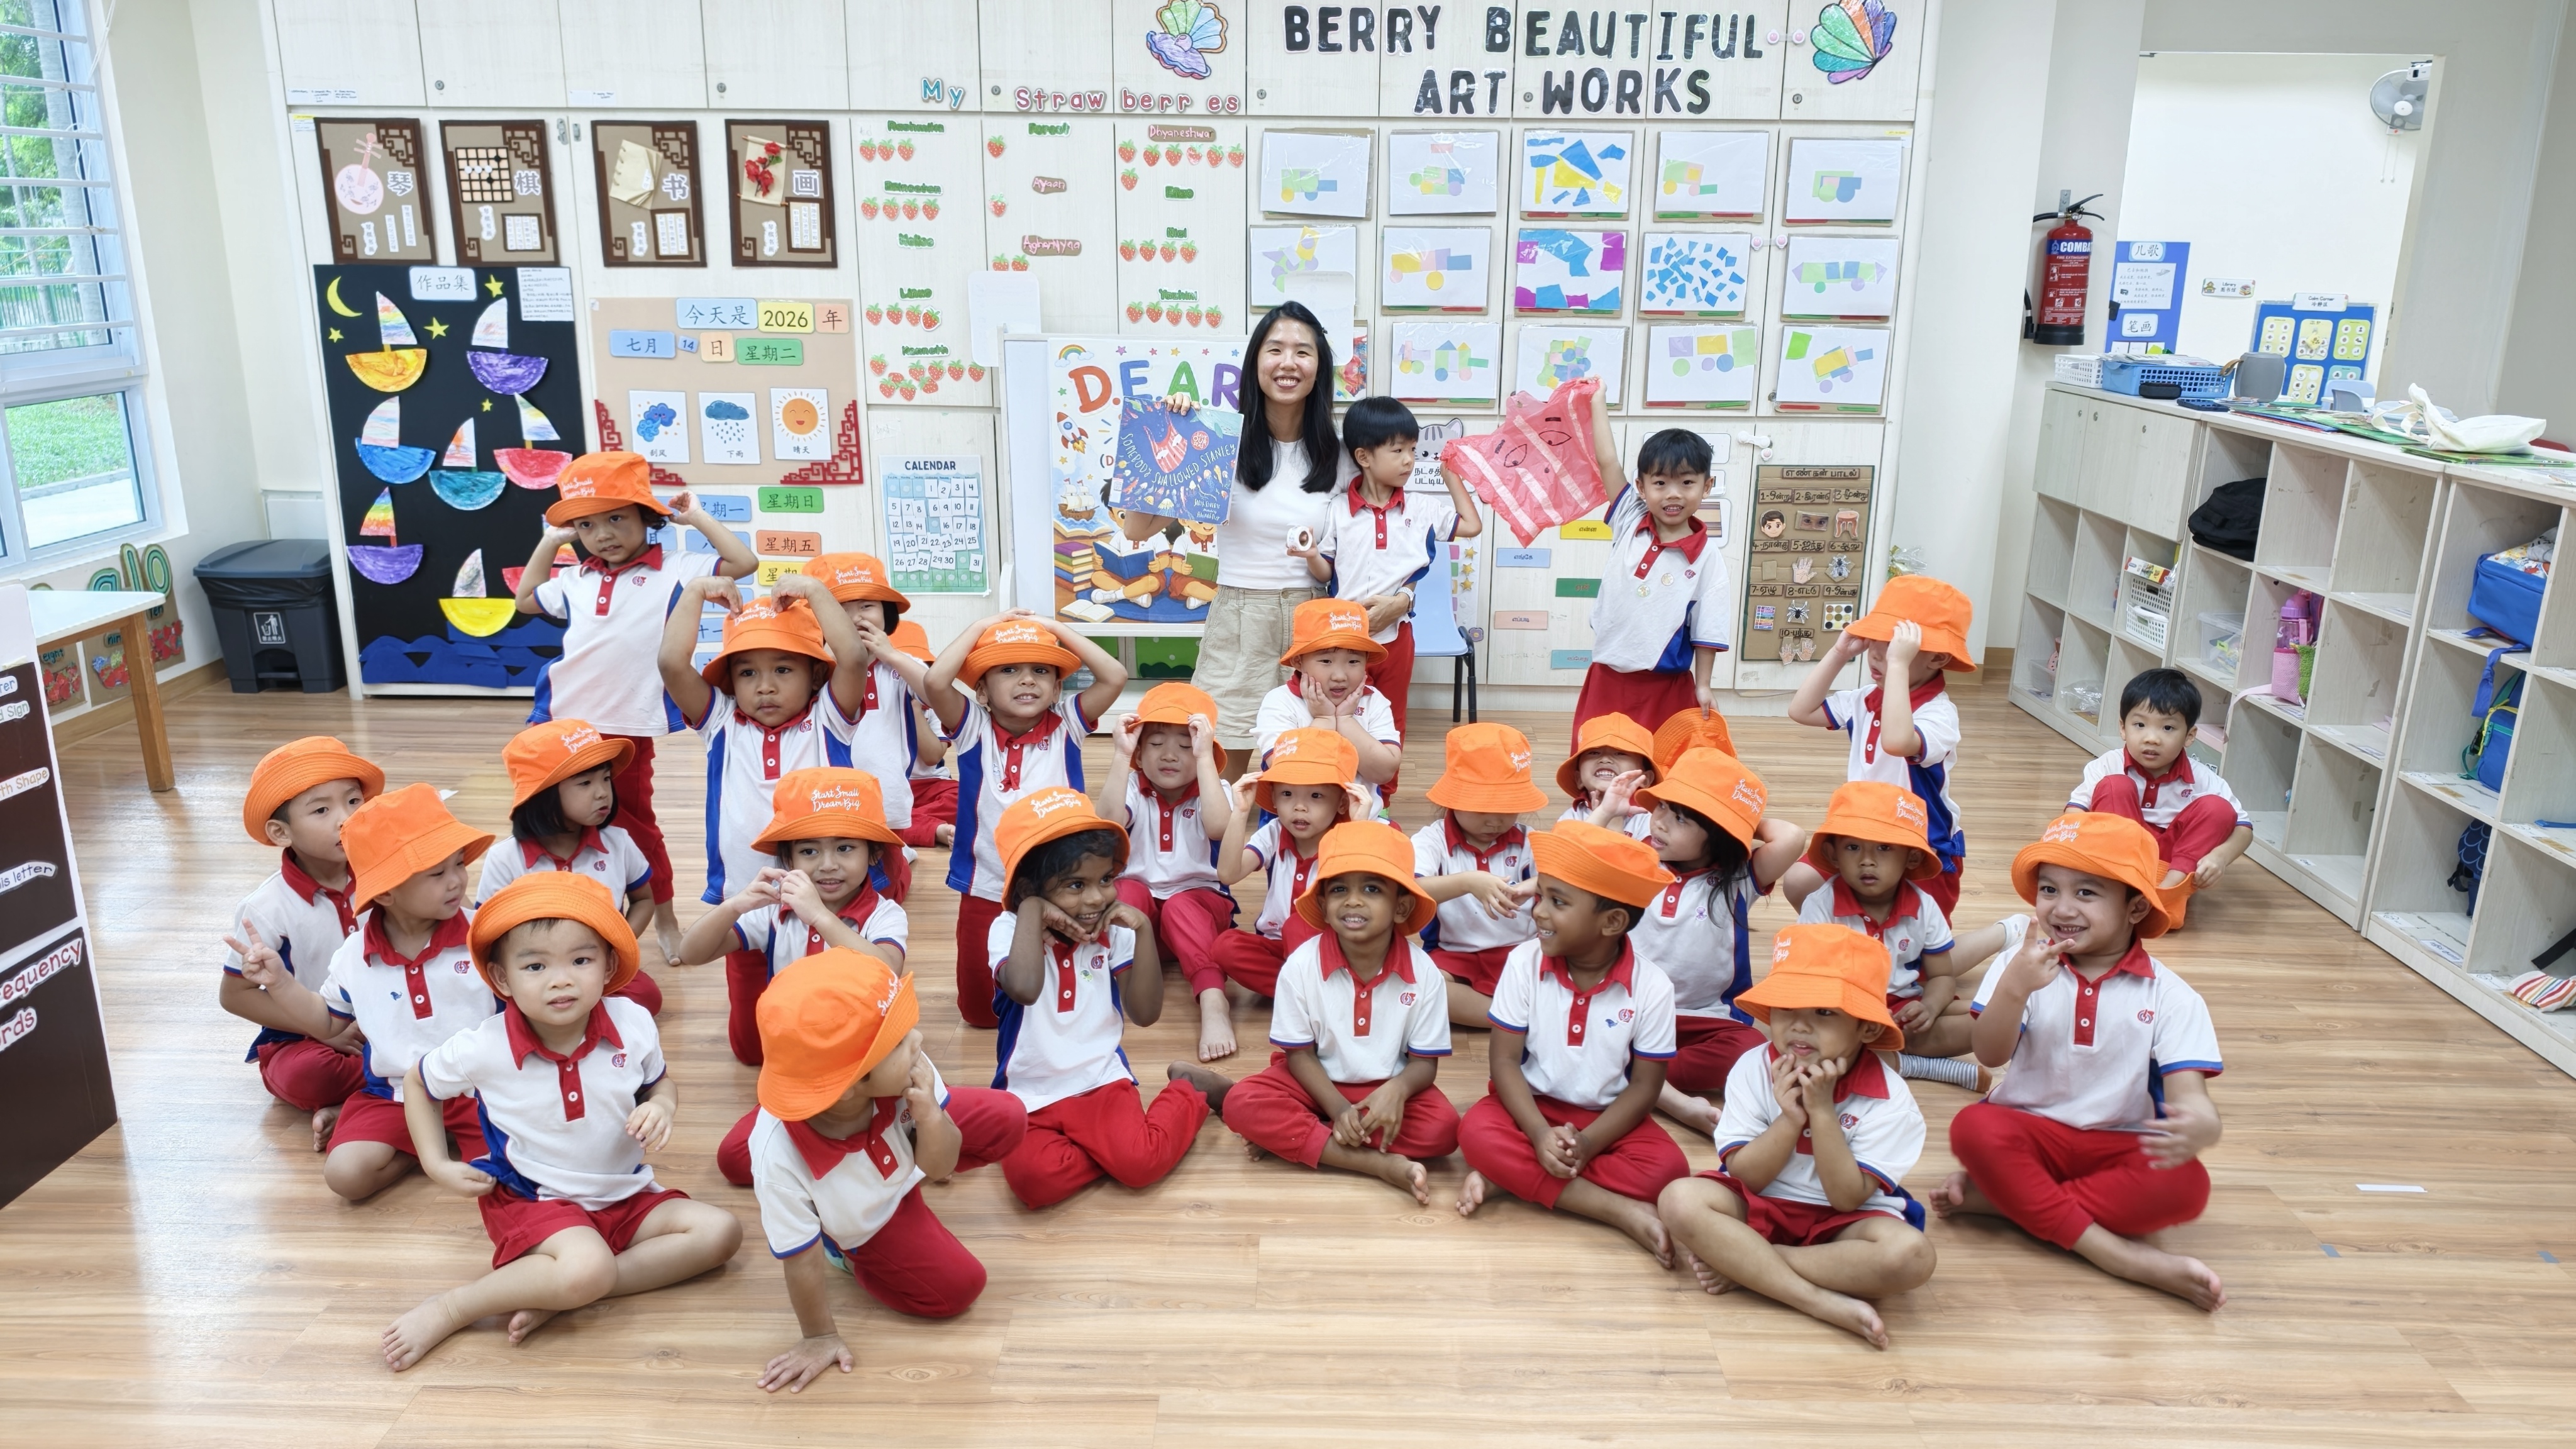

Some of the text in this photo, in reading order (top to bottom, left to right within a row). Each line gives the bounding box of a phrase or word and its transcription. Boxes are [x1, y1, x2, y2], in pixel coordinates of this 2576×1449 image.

[1285, 5, 1763, 60] BERRY BEAUTIFUL
[922, 78, 963, 109] My
[1416, 68, 1711, 114] ART WORKS
[1150, 125, 1213, 139] Dhyaneshwar
[389, 172, 413, 195] 琴
[516, 173, 540, 194] 棋
[665, 176, 688, 199] 书
[795, 172, 818, 195] 画
[2135, 245, 2159, 257] 儿歌
[418, 275, 470, 292] 作品集
[684, 304, 750, 325] 今天是
[764, 310, 809, 328] 2026
[822, 309, 843, 331] 年
[2127, 320, 2151, 333] 笔画
[626, 338, 657, 353] 七月
[682, 340, 695, 350] 14
[711, 340, 723, 356] 日
[744, 345, 796, 362] 星期二
[650, 449, 667, 457] 刮风
[726, 450, 744, 458] 下雨
[793, 446, 811, 454] 晴天
[904, 460, 957, 471] CALENDAR
[1152, 462, 1199, 487] SWALLOWED
[1199, 443, 1236, 467] STANLEY
[767, 493, 814, 510] 星期日
[764, 537, 815, 553] 星期五
[933, 555, 942, 564] 29
[836, 566, 870, 580] Start Small
[735, 614, 758, 627] Dream
[1330, 612, 1346, 623] Start
[1331, 620, 1363, 631] Dream Big
[108, 633, 121, 644] nin
[994, 625, 1037, 639] Start Small
[7, 703, 29, 718] Sign
[16, 769, 48, 790] Shape
[811, 786, 860, 801] Start Small
[1735, 779, 1753, 797] Start
[813, 798, 861, 813] Dream Big
[1030, 791, 1076, 810] Start Small
[1732, 789, 1753, 806] Dream
[1033, 797, 1082, 819] Dream Big
[2059, 830, 2079, 843] Big
[13, 865, 53, 882] letter
[2, 941, 82, 1001] equency
[0, 1011, 35, 1045] rds
